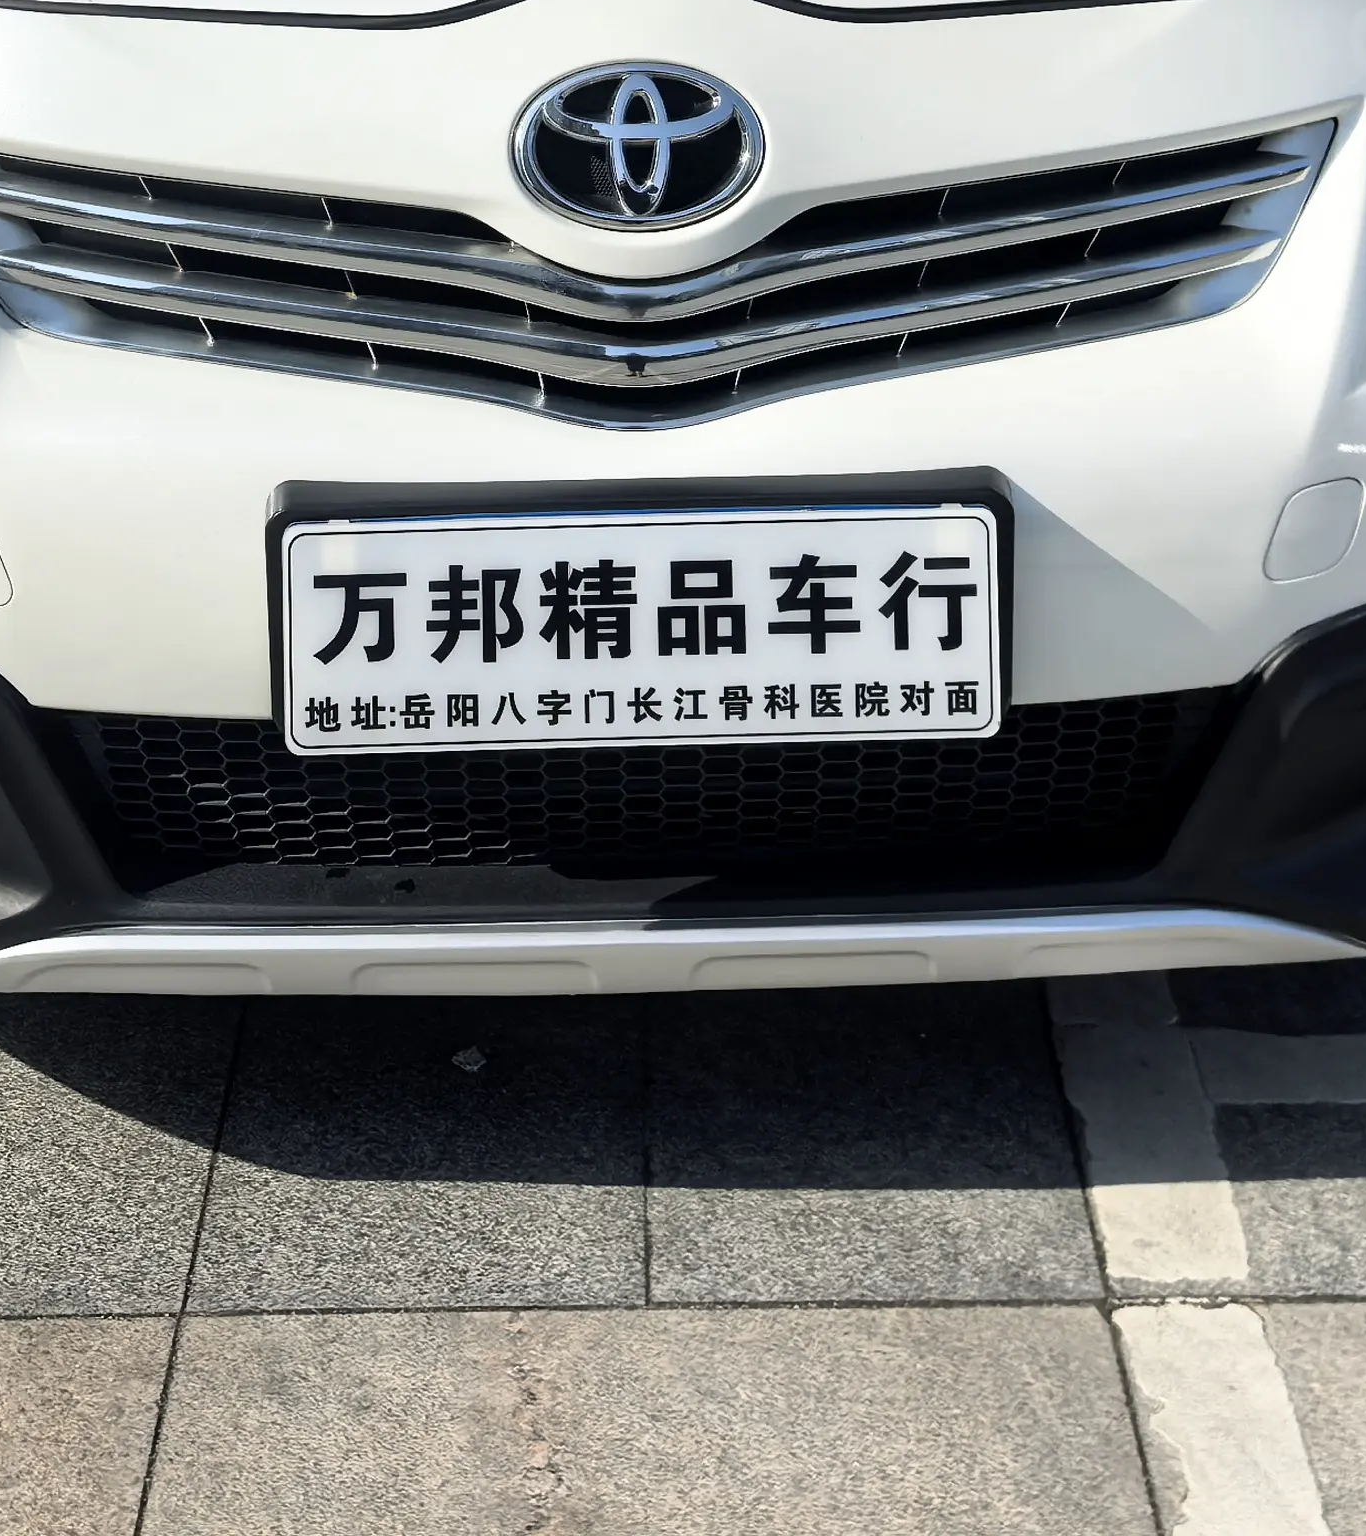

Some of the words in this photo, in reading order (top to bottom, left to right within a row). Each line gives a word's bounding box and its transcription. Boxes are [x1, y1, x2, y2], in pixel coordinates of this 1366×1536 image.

[313, 550, 978, 665] 万邦精品车行
[304, 680, 979, 733] 地址:岳阳八字门长江骨科医院对面
